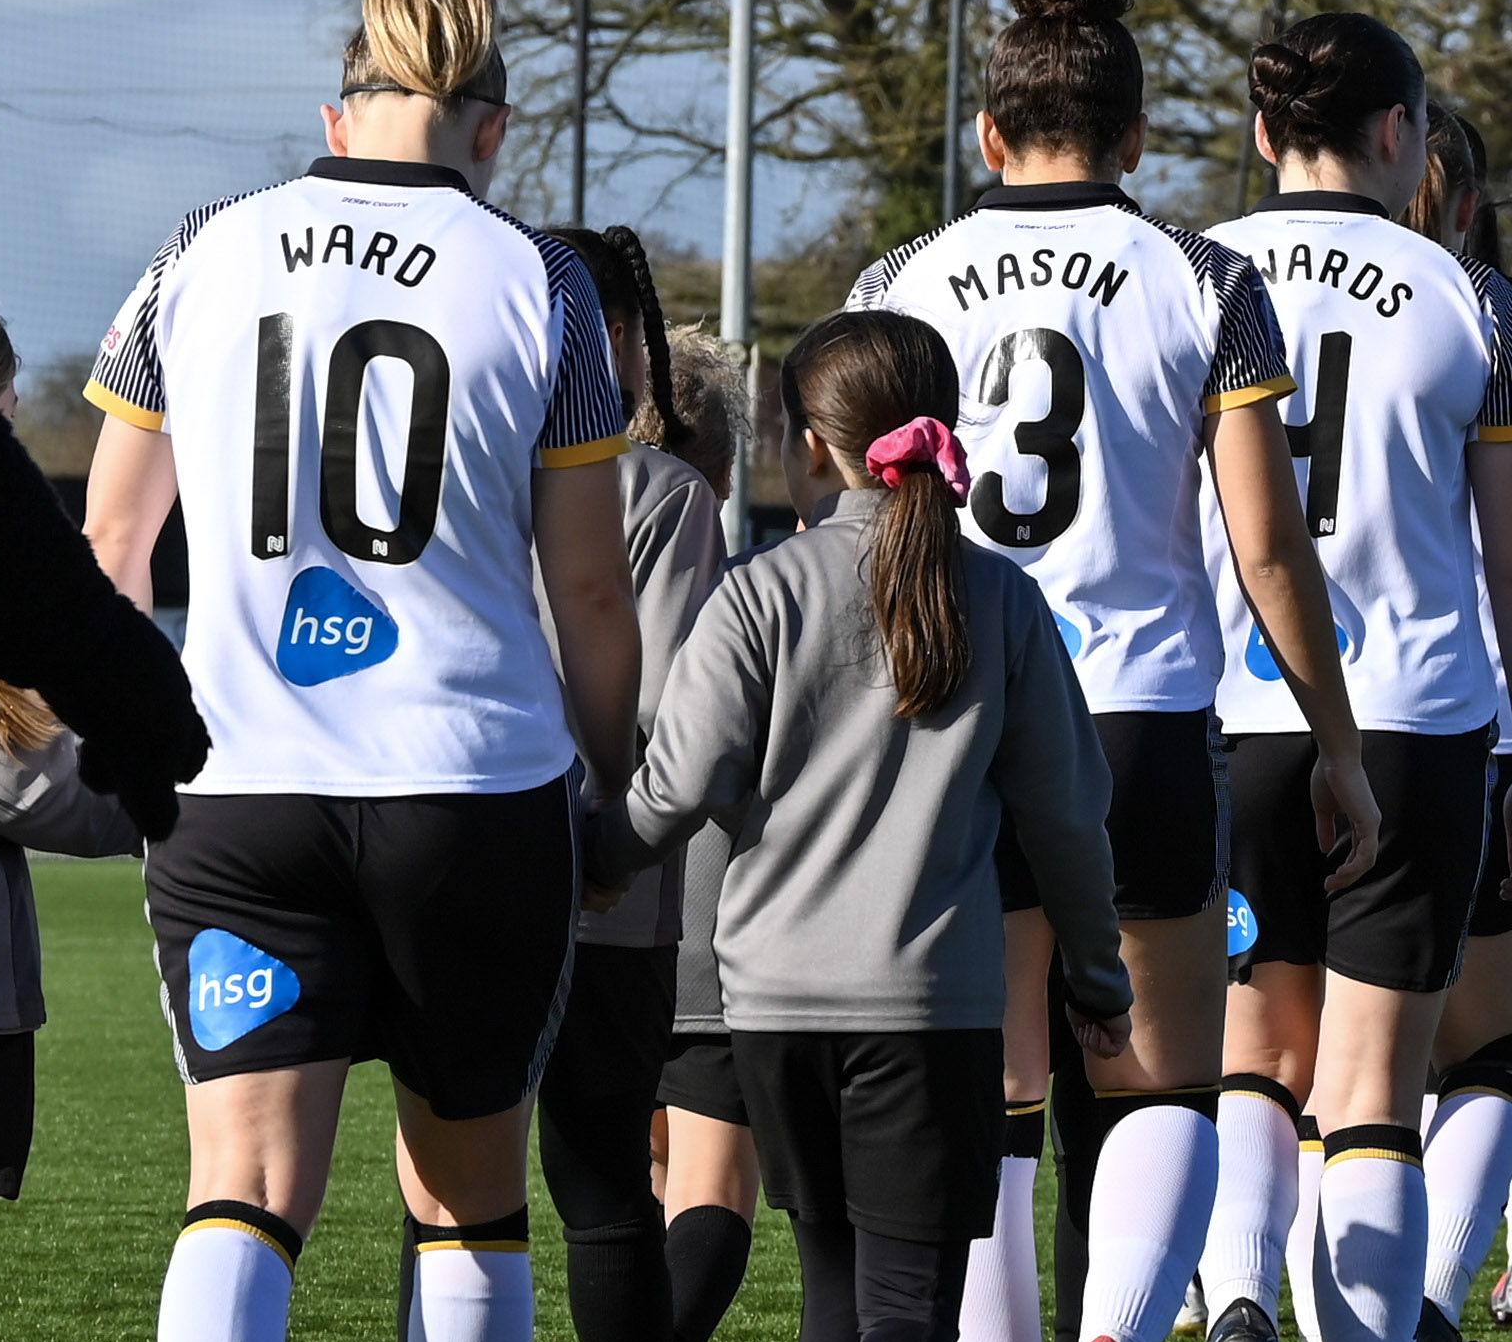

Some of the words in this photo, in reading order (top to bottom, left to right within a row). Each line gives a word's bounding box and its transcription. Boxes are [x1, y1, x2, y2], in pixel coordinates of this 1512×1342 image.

[281, 224, 436, 288] WARD
[948, 248, 1129, 312] MASON
[251, 312, 451, 565] 10
[969, 327, 1087, 549] 3
[291, 608, 374, 655] hsg
[1227, 906, 1249, 937] sg
[198, 963, 273, 1011] hsg
